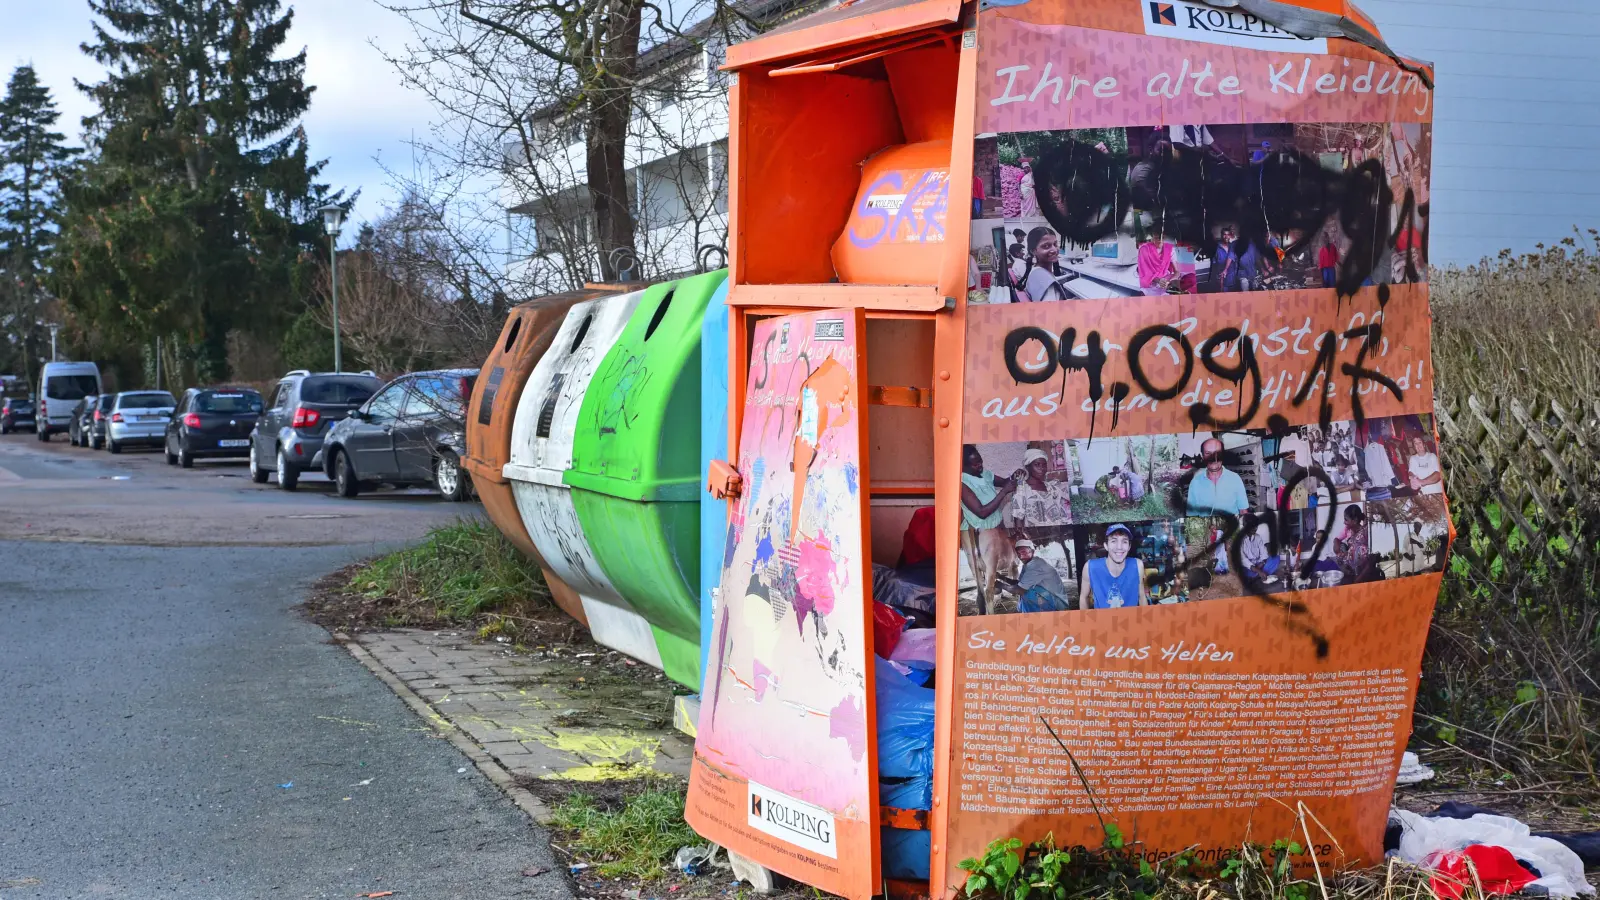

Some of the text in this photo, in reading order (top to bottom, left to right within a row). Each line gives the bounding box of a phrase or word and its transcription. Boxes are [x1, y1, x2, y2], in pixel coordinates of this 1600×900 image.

[990, 57, 1431, 116] Ihre alte Kleidung
[981, 391, 1060, 420] aus
[1180, 377, 1235, 408] die
[967, 630, 1236, 664] Sie helfen uns Helfen
[966, 660, 1025, 673] Grundbildung
[1042, 665, 1071, 674] Kinder
[1092, 668, 1142, 680] Jugendliche
[1203, 672, 1250, 680] indianischen
[965, 670, 1008, 680] wahrloste
[1011, 673, 1040, 682] Kinder
[1061, 676, 1077, 685] ihre
[1116, 679, 1163, 688] Trinkwasser
[1191, 682, 1261, 691] Cajamarca-Region
[1268, 681, 1292, 689] Mobile
[994, 682, 1024, 692] Leben:
[1027, 684, 1072, 695] Zisternen-
[1093, 688, 1143, 699] Pumpenbau
[1155, 691, 1220, 699] Nordost-Brasilien
[992, 692, 1038, 703] Kolumbien
[1048, 696, 1074, 705] Gutes
[1077, 697, 1129, 707] Lehrmaterial
[1158, 700, 1182, 708] Padre
[1209, 700, 1264, 710] Kolping-Schule
[964, 711, 983, 719] bien
[985, 712, 1029, 722] Sicherheit
[1051, 716, 1109, 728] Geborgenheit
[1132, 719, 1186, 727] Sozialzentrum
[1200, 719, 1224, 727] Kinder
[1255, 718, 1284, 726] mindern
[1085, 708, 1137, 717] Bio-Landbau
[1149, 710, 1186, 719] Paraguay
[1239, 709, 1262, 717] lernen
[998, 723, 1032, 733] effektiv:
[1080, 728, 1115, 736] Lasttiere
[1186, 728, 1258, 738] Ausbildungszentren
[963, 731, 1008, 743] betreuung
[1093, 738, 1116, 748] Aplao
[1250, 736, 1269, 744] Mato
[962, 741, 1015, 752] Konzertsaal
[1091, 748, 1138, 757] Mittagessen
[1152, 747, 1190, 757] bedürftige
[1192, 747, 1216, 755] Kinder
[1223, 746, 1240, 754] Eine
[995, 753, 1029, 763] Chance
[1048, 756, 1067, 765] eine
[1147, 757, 1178, 765] Latrinen
[1180, 756, 1219, 764] verhindern
[1221, 754, 1264, 763] Krankheiten
[961, 773, 1011, 784] versorgung
[1014, 775, 1069, 784] afrikanischer
[1107, 776, 1152, 784] Abendkurse
[1166, 773, 1226, 784] Plantagenkinder
[1248, 772, 1270, 780] Lanka
[1014, 765, 1034, 773] Eine
[1037, 766, 1067, 775] Schule
[1096, 767, 1147, 777] Jugendlichen
[1256, 763, 1290, 771] Zisternen
[987, 783, 1007, 792] Eine
[1108, 785, 1148, 795] Ernährung
[1164, 783, 1196, 792] Familien
[1205, 782, 1222, 790] Eine
[1223, 781, 1263, 791] Ausbildung
[960, 791, 982, 801] kunft
[995, 794, 1026, 803] Bäume
[1029, 796, 1059, 804] sichern
[1124, 793, 1178, 802] Inselbewohner
[1186, 791, 1229, 800] Werkstätten
[960, 802, 1045, 813] Mädchenwohnheim
[1117, 802, 1165, 813] Schulbildung
[1179, 800, 1213, 809] Mädchen
[766, 799, 831, 844] KOLPING
[797, 852, 817, 867] KOLPING
